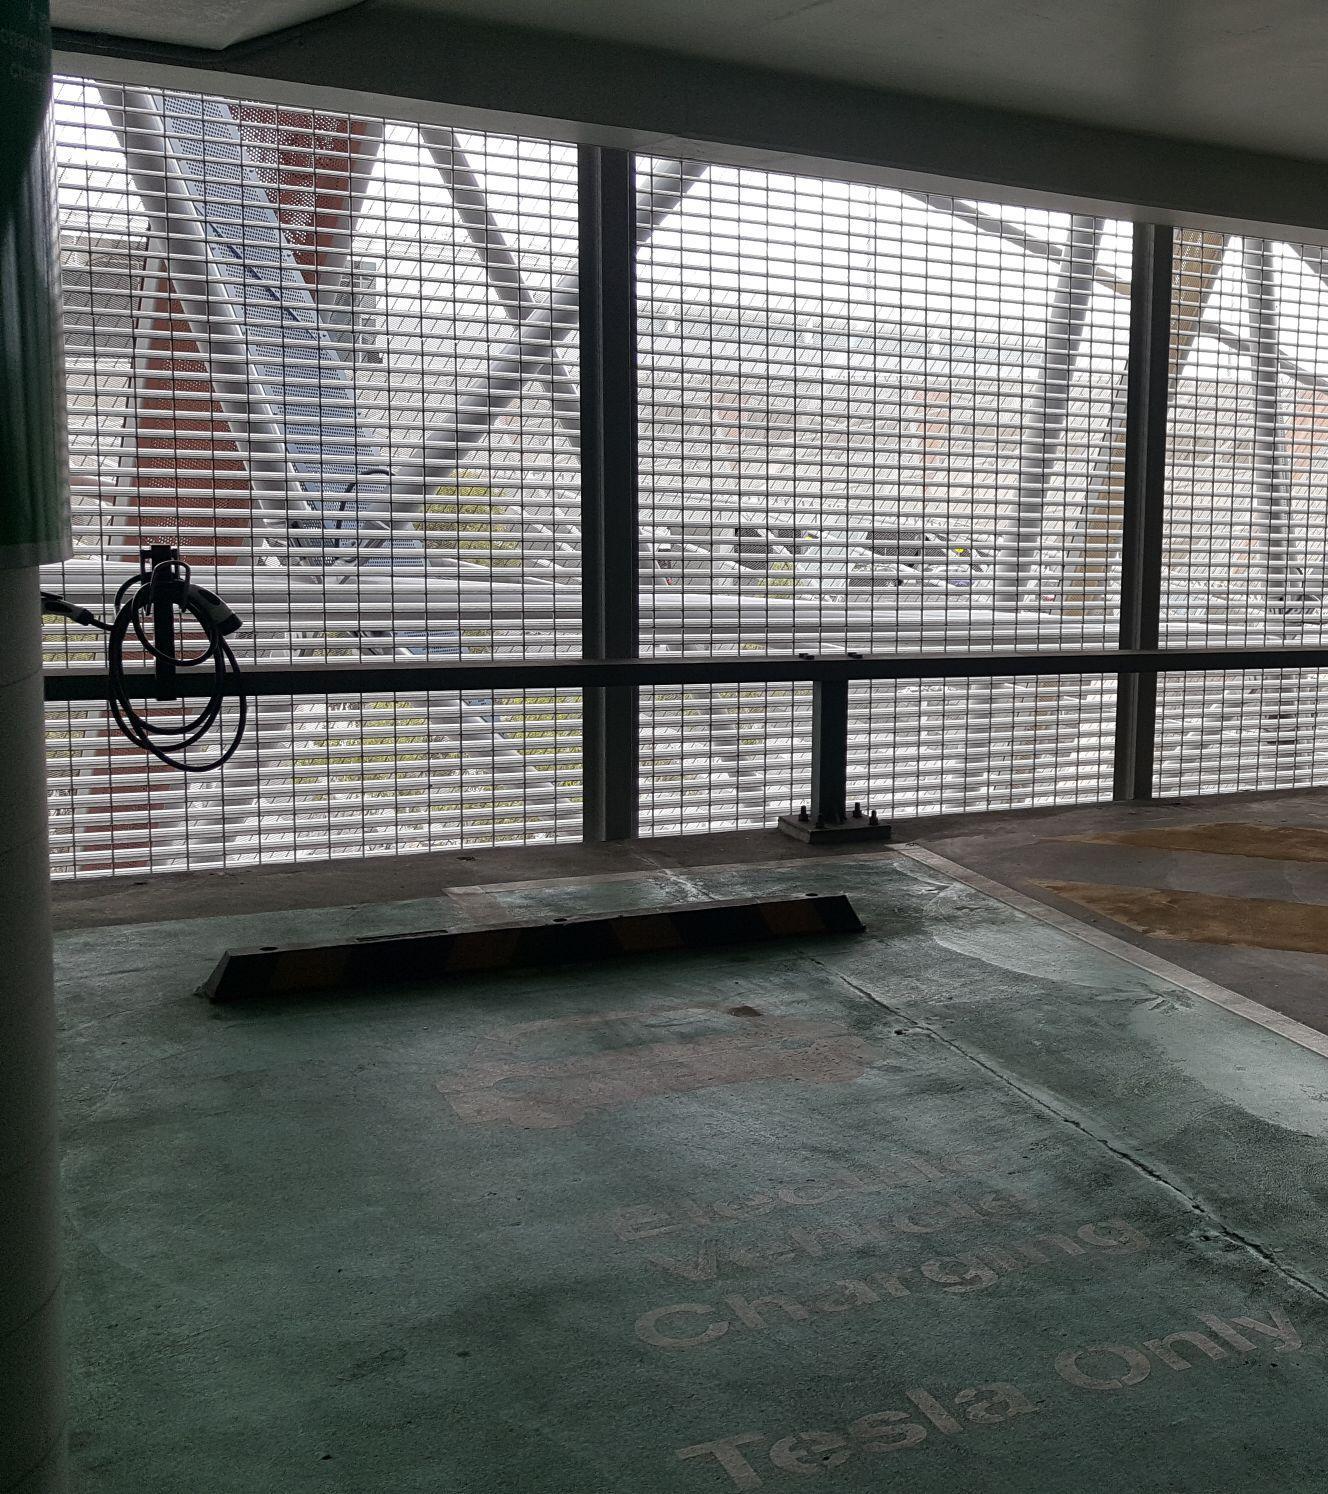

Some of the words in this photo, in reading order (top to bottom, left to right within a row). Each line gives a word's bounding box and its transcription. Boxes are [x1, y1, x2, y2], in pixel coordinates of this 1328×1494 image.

[635, 1215, 1151, 1352] Charging
[676, 1382, 1041, 1492] Tesla
[1055, 1305, 1304, 1392] Only
